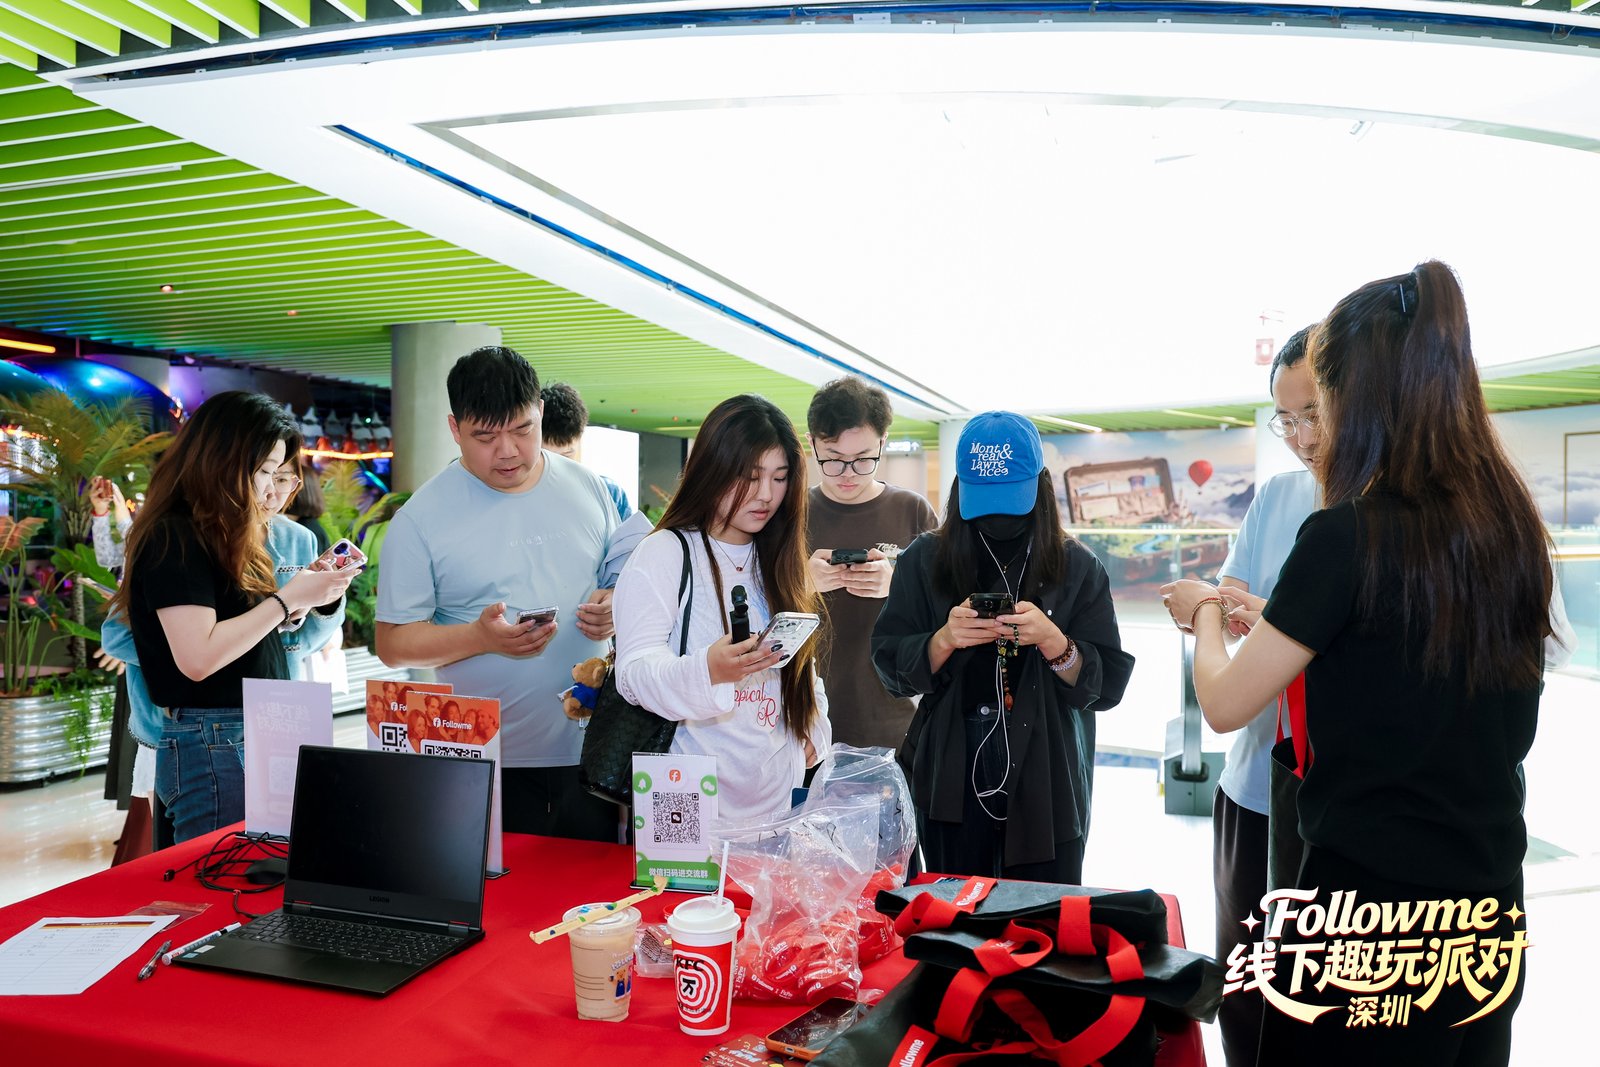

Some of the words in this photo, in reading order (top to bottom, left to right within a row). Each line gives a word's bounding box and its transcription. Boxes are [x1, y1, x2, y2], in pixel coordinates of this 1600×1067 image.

[969, 443, 1000, 453] Mont
[442, 719, 473, 730] Followme
[648, 867, 709, 879] 微信扫码进交流群
[676, 955, 704, 971] KFC
